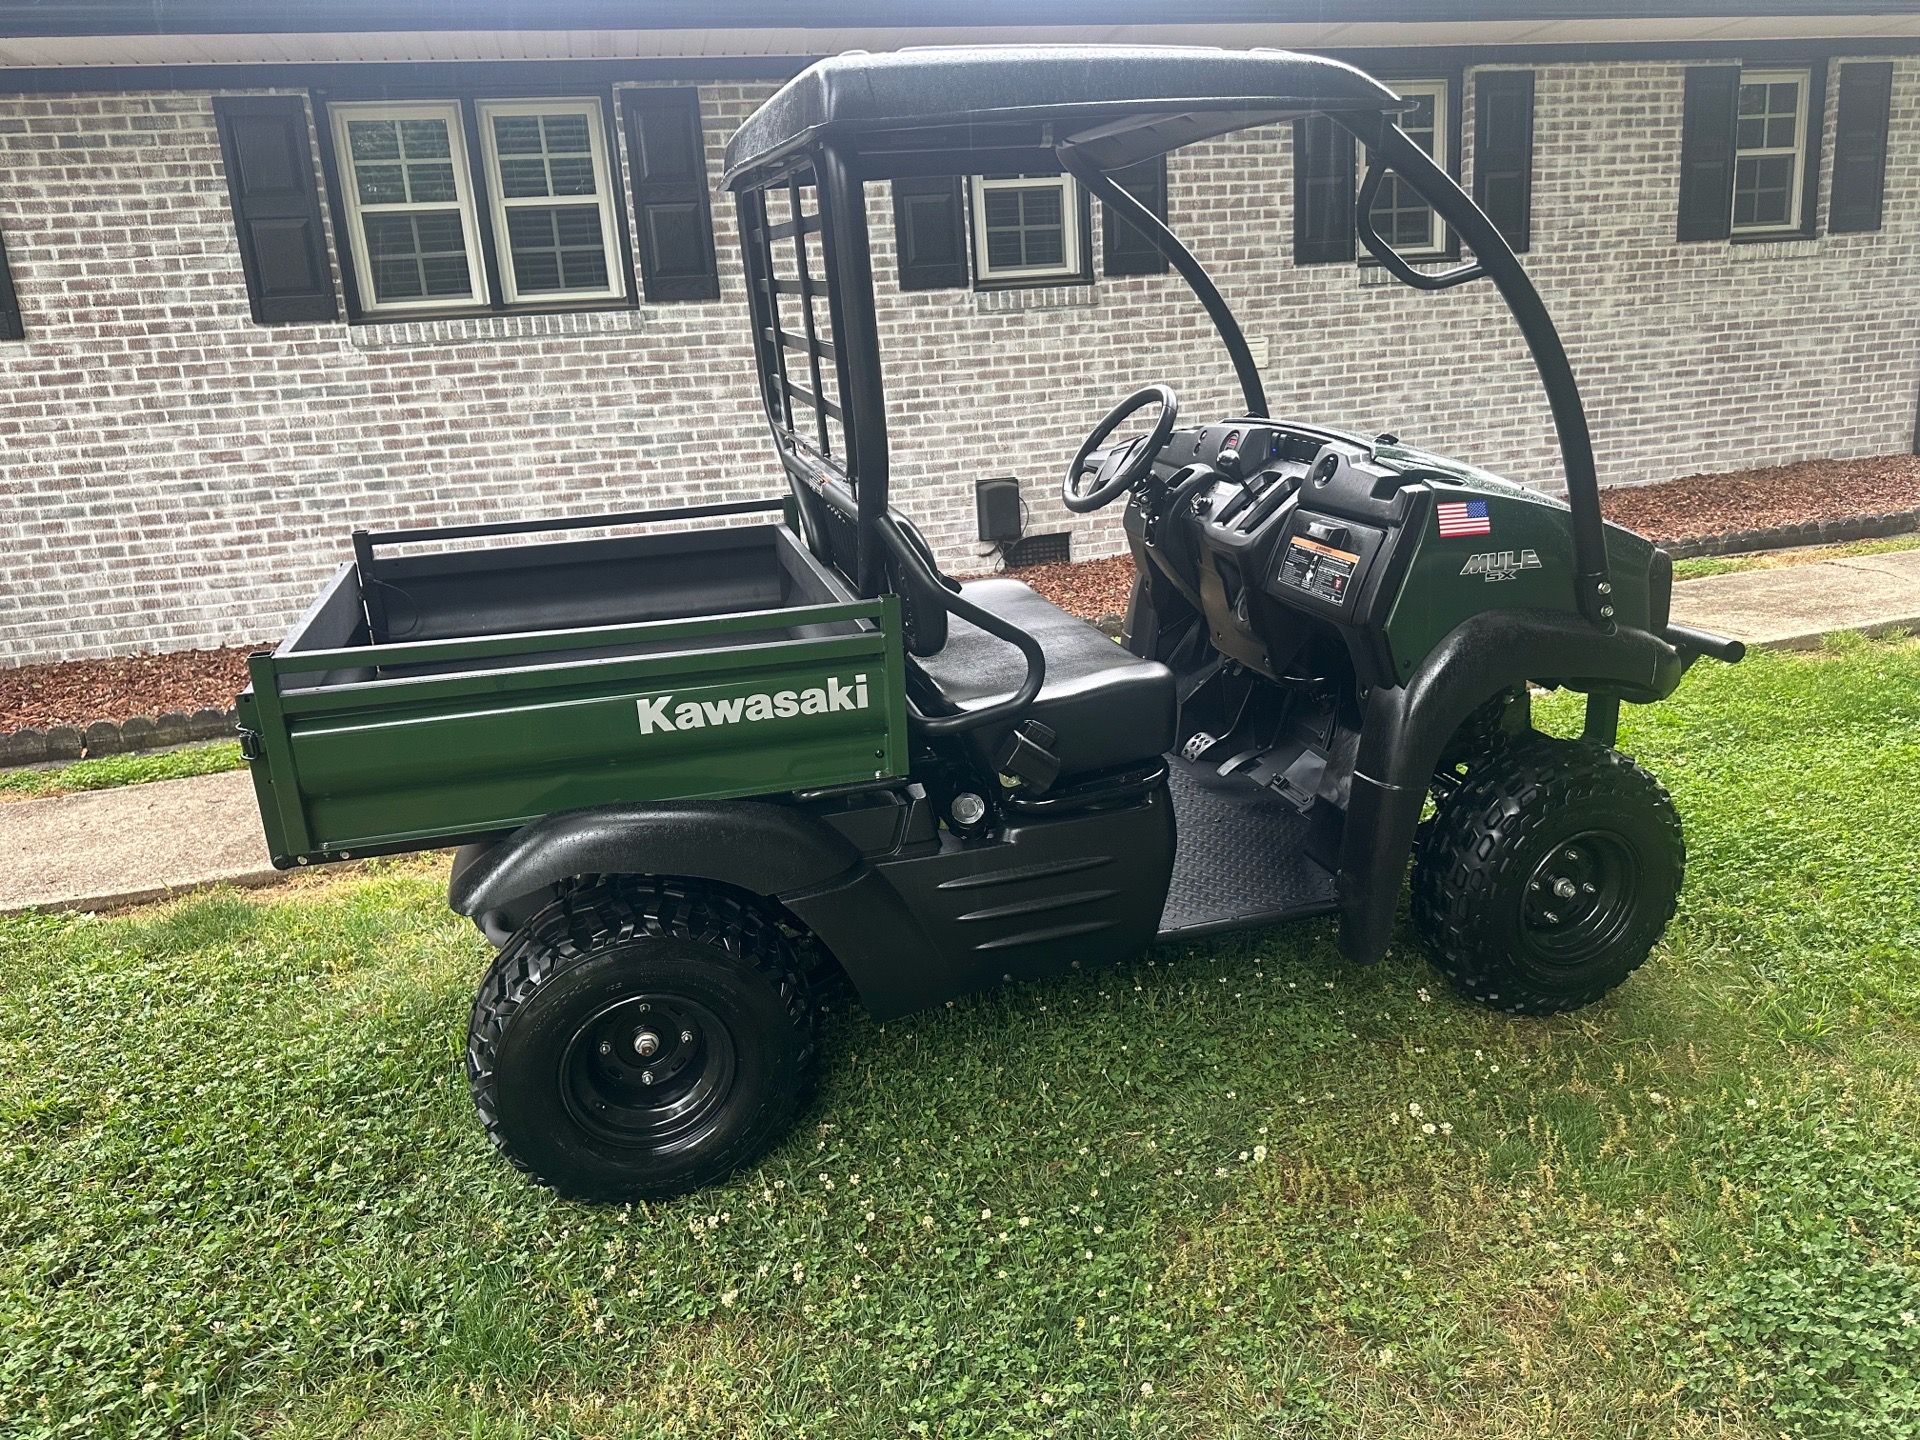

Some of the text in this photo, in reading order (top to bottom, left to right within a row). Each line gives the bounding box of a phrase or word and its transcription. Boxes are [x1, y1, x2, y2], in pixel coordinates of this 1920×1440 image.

[1460, 549, 1542, 575] MULE
[1485, 569, 1517, 582] SX
[636, 674, 869, 735] Kawasaki
